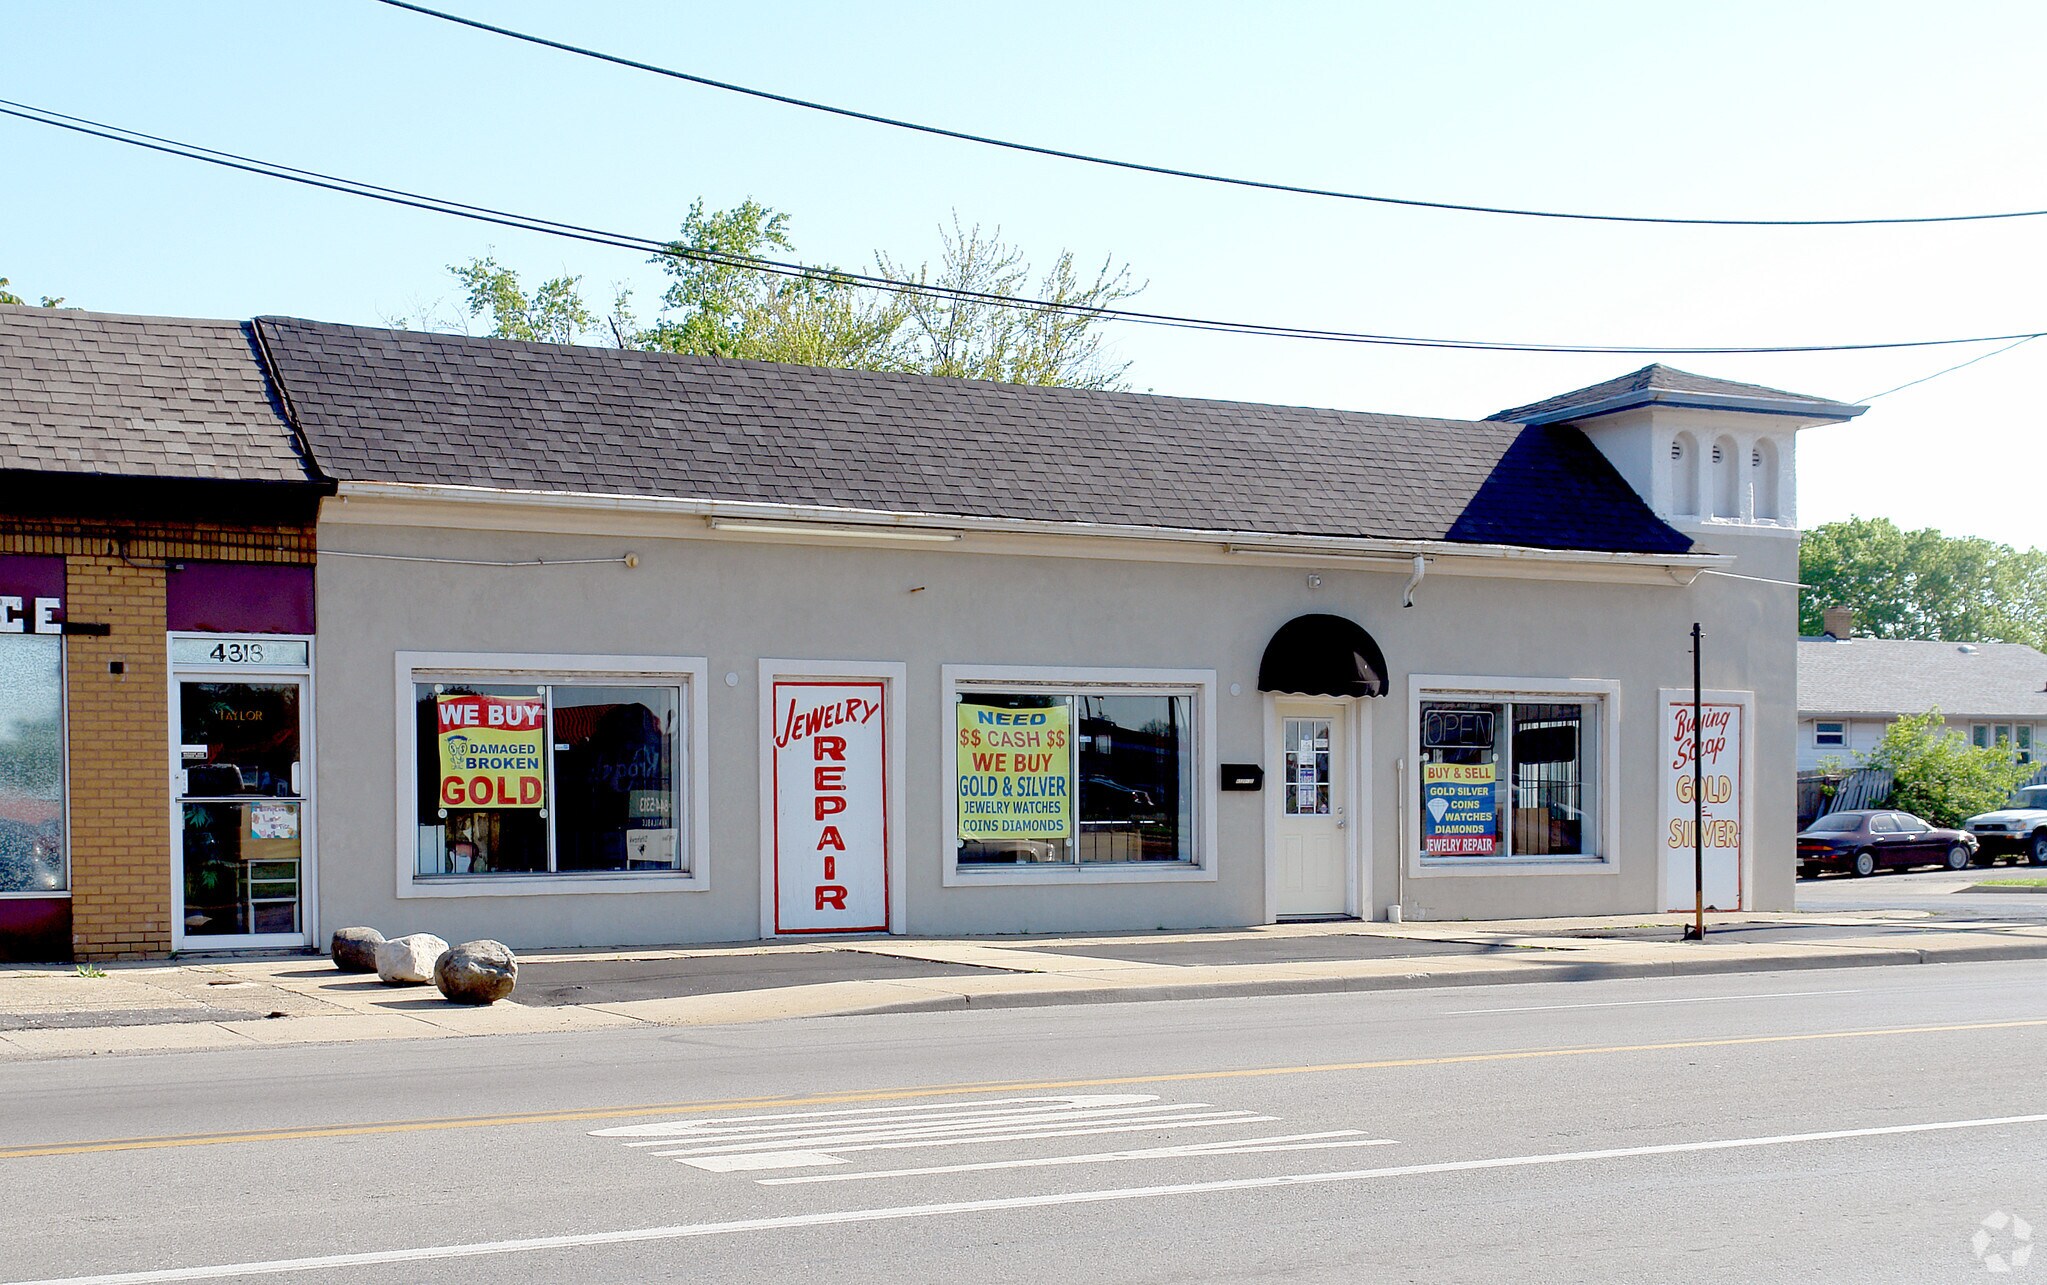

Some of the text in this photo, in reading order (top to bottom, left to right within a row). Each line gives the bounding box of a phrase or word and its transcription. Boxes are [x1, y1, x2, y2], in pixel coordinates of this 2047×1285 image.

[440, 704, 540, 726] WE BUY
[977, 711, 1047, 726] NEED
[775, 698, 880, 749] JEWELRY
[1427, 713, 1491, 744] OPEN
[960, 728, 1066, 749] $$ CASH $$
[469, 743, 536, 755] DAMAGED
[465, 757, 539, 770] BROKEN
[972, 753, 1053, 772] WE BUY
[1428, 767, 1491, 779] BUY & SELL
[441, 775, 542, 805] GOLD
[960, 775, 1067, 797] GOLD & SILVER
[1430, 787, 1489, 796] GOLD SILVER
[964, 801, 1061, 815] JEWELRY WATCHES
[1451, 800, 1480, 809] COINS
[813, 735, 849, 911] REPAIR
[1445, 812, 1493, 821] WATCHES
[963, 819, 1064, 832] COINS DIAMONDS
[1435, 825, 1484, 833] DIAMONDS
[1427, 838, 1493, 852] JEWELRY REPAIR
